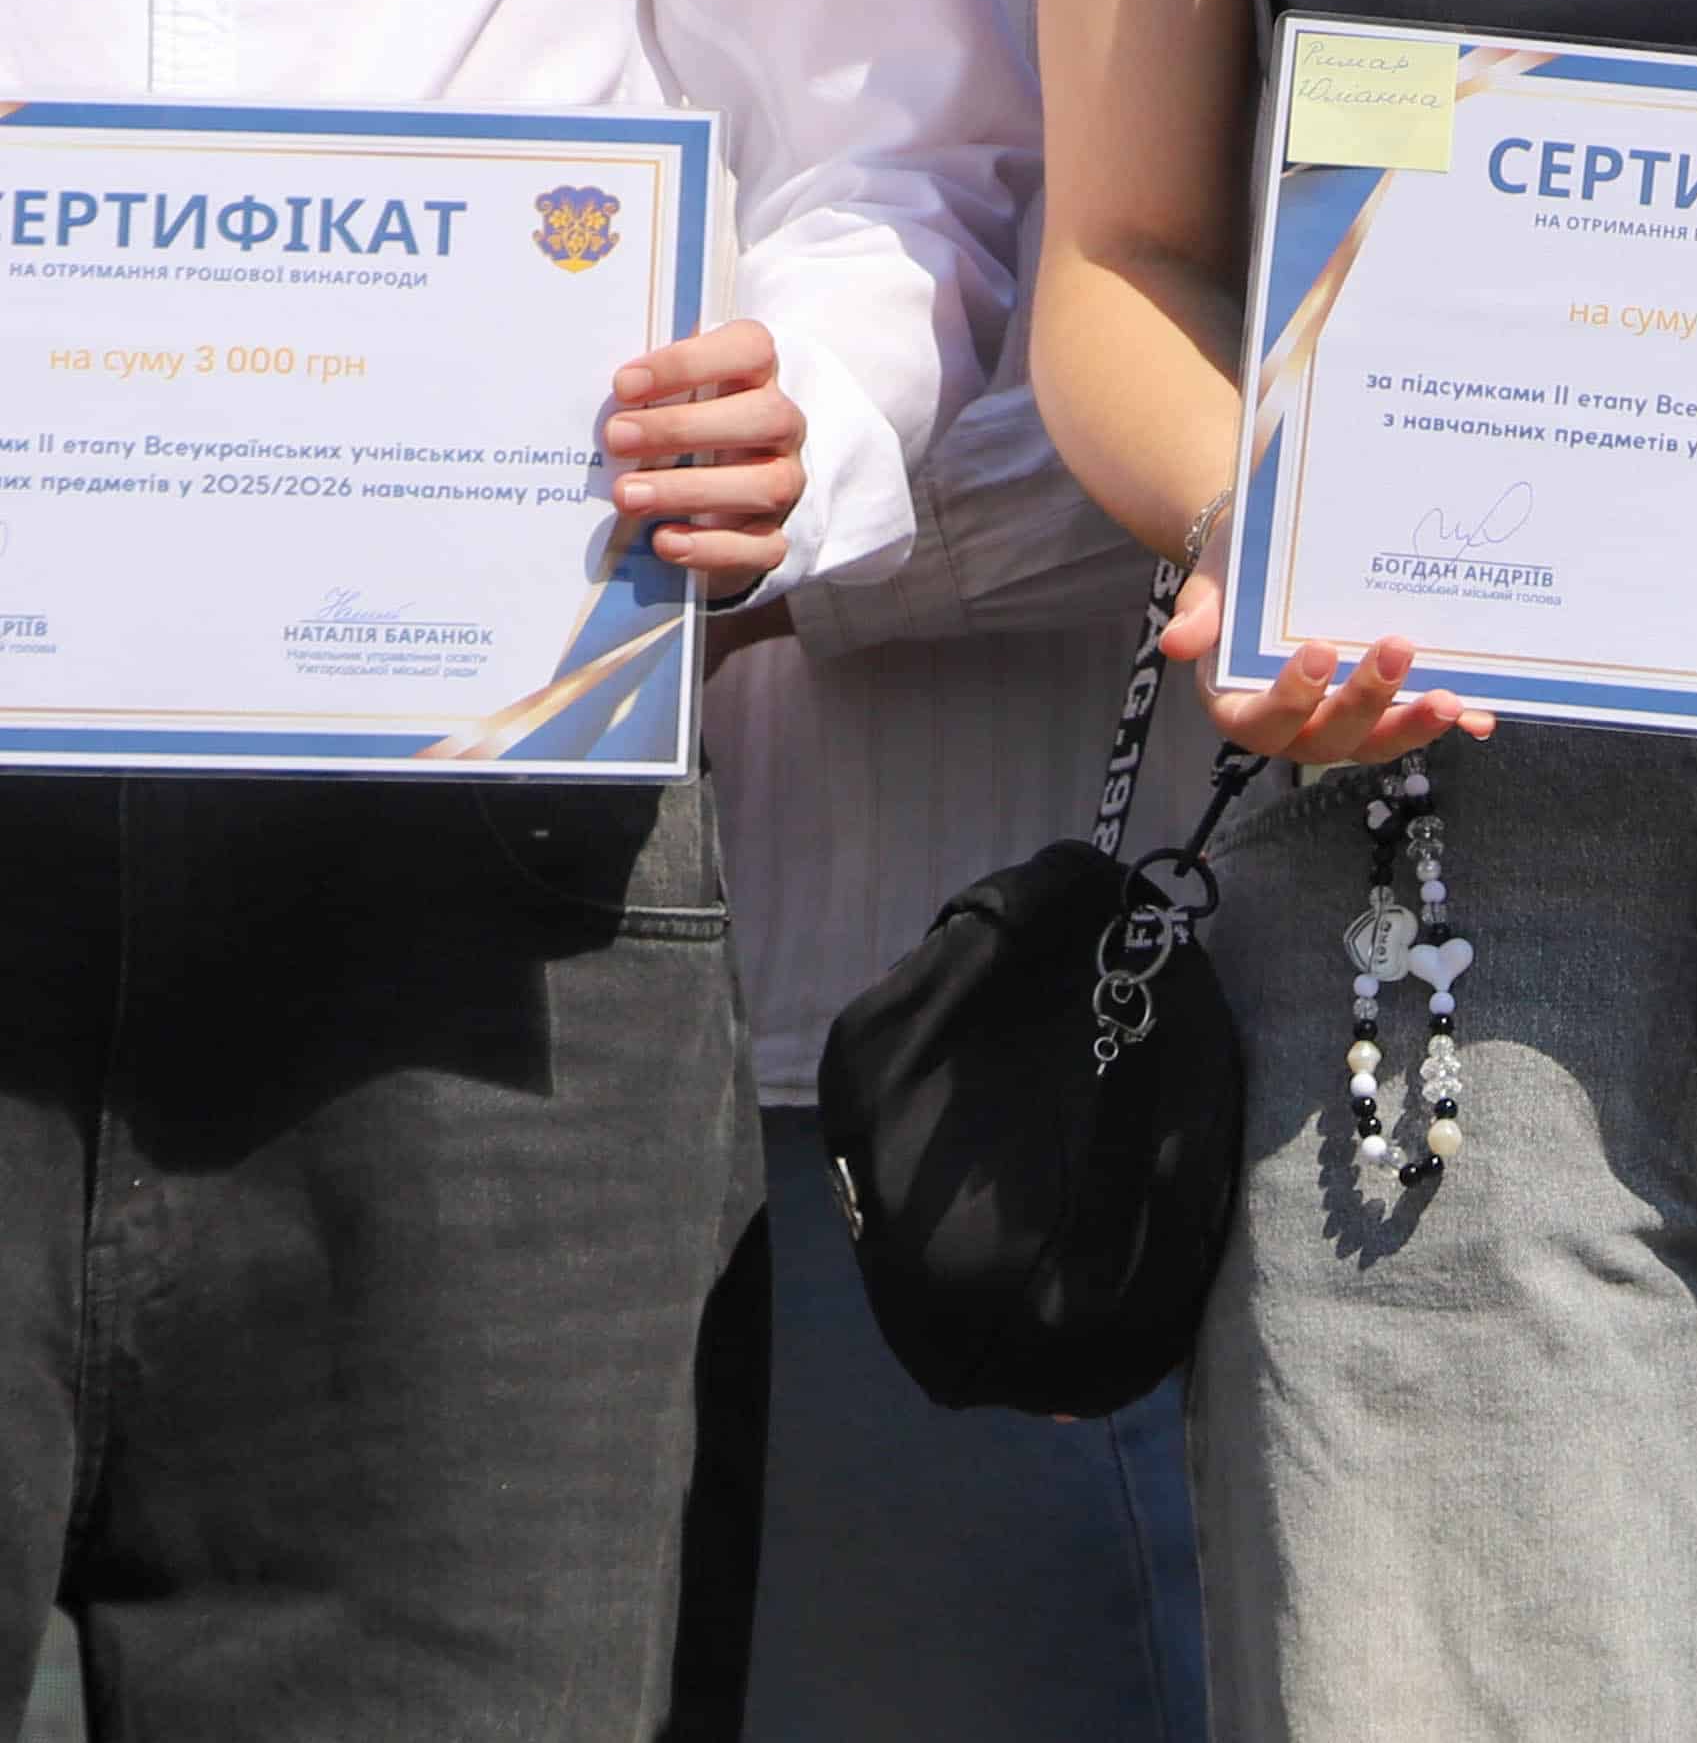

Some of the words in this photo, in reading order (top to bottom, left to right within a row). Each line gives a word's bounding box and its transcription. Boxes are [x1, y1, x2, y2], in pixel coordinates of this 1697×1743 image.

[0, 189, 467, 256] ЕРТИФІКАТ
[1534, 213, 1560, 228] НА
[1566, 216, 1688, 239] ОТРИМАННЯ
[9, 263, 36, 276] НА
[41, 263, 168, 279] ОТРИМАННЯ
[174, 266, 283, 282] ГРОШОВОЇ
[289, 269, 427, 288] ВИНАГОРОДИ
[1569, 304, 1610, 327] на
[49, 349, 92, 370] на
[103, 350, 186, 380] суму
[194, 344, 216, 373] 3
[226, 346, 296, 374] 000
[306, 354, 366, 384] грн
[1366, 374, 1392, 389] за
[1401, 375, 1544, 402] підсумками
[1577, 393, 1647, 416] етапу
[1383, 413, 1394, 427] з
[1402, 416, 1545, 439] навчальних
[1554, 428, 1678, 451] предметів
[62, 440, 136, 458] етапу
[144, 435, 341, 460] Всеукраїнських
[351, 443, 484, 463] учнівських
[493, 445, 604, 468] олімпіад
[40, 474, 170, 493] предметів
[178, 480, 192, 497] у
[201, 474, 352, 496] 2025/2026
[361, 484, 528, 504] навчальному
[1371, 557, 1457, 579] БОГДАН
[1463, 565, 1553, 586] АНДРІЇВ
[283, 626, 376, 642] НАТАЛІЯ
[384, 627, 492, 644] БАРАНЮК
